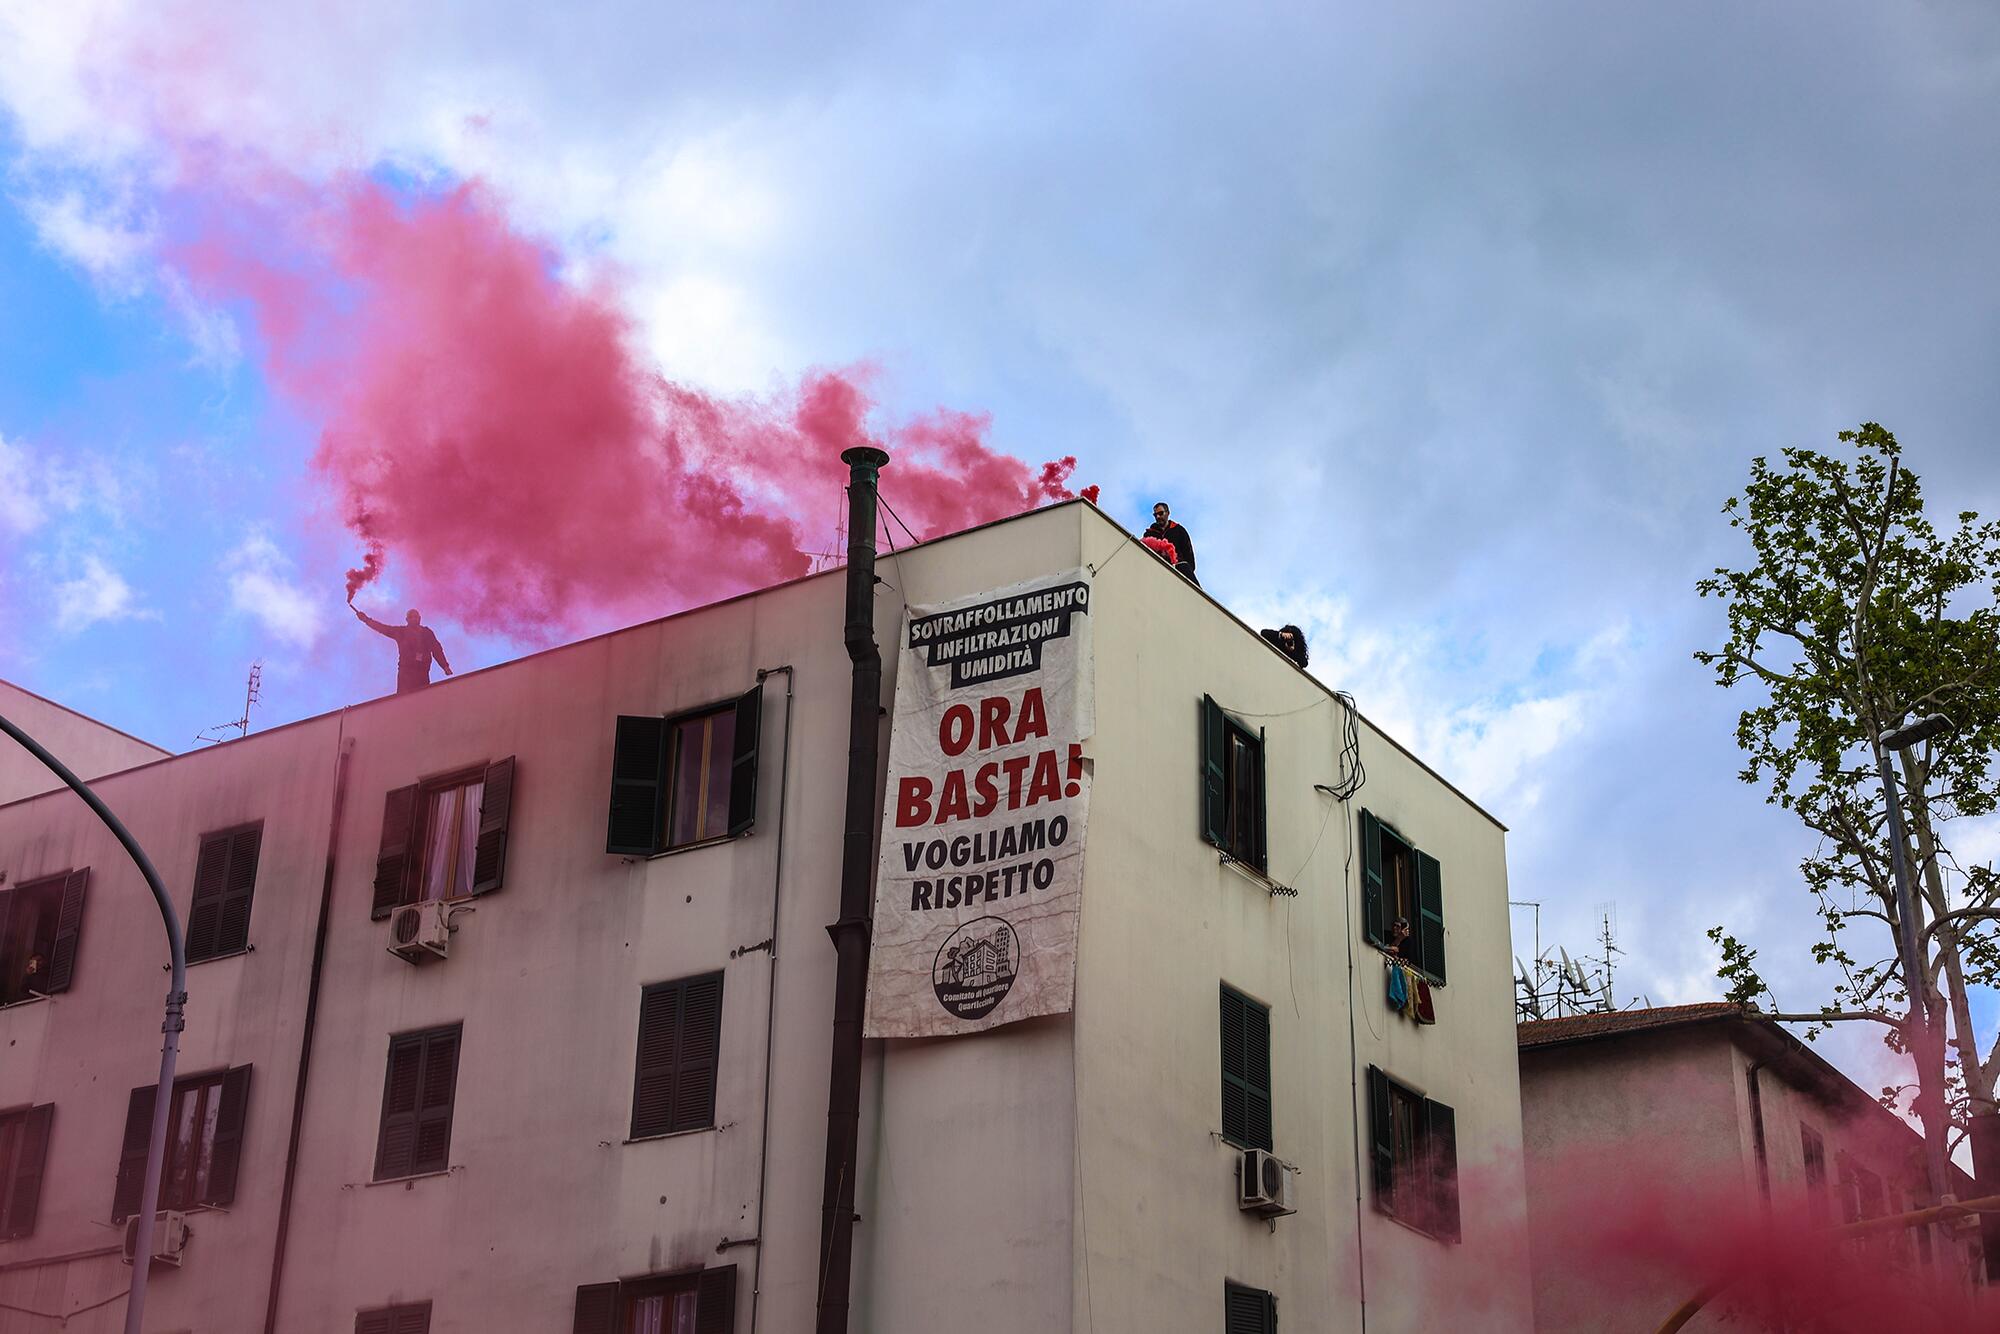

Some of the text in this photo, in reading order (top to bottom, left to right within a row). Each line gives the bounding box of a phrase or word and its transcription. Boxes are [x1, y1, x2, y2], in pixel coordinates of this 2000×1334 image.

[911, 587, 1087, 641] SOVRAFFOLLAMENTO
[936, 617, 1059, 661] INFILTRAZIONI
[960, 645, 1033, 680] UMIDITÀ
[939, 687, 1049, 757] ORA
[896, 744, 1083, 827] BASTA!
[903, 815, 1068, 872] VOGLIAMO
[911, 858, 1054, 911] RISPETTO
[943, 992, 975, 1001] Comitato
